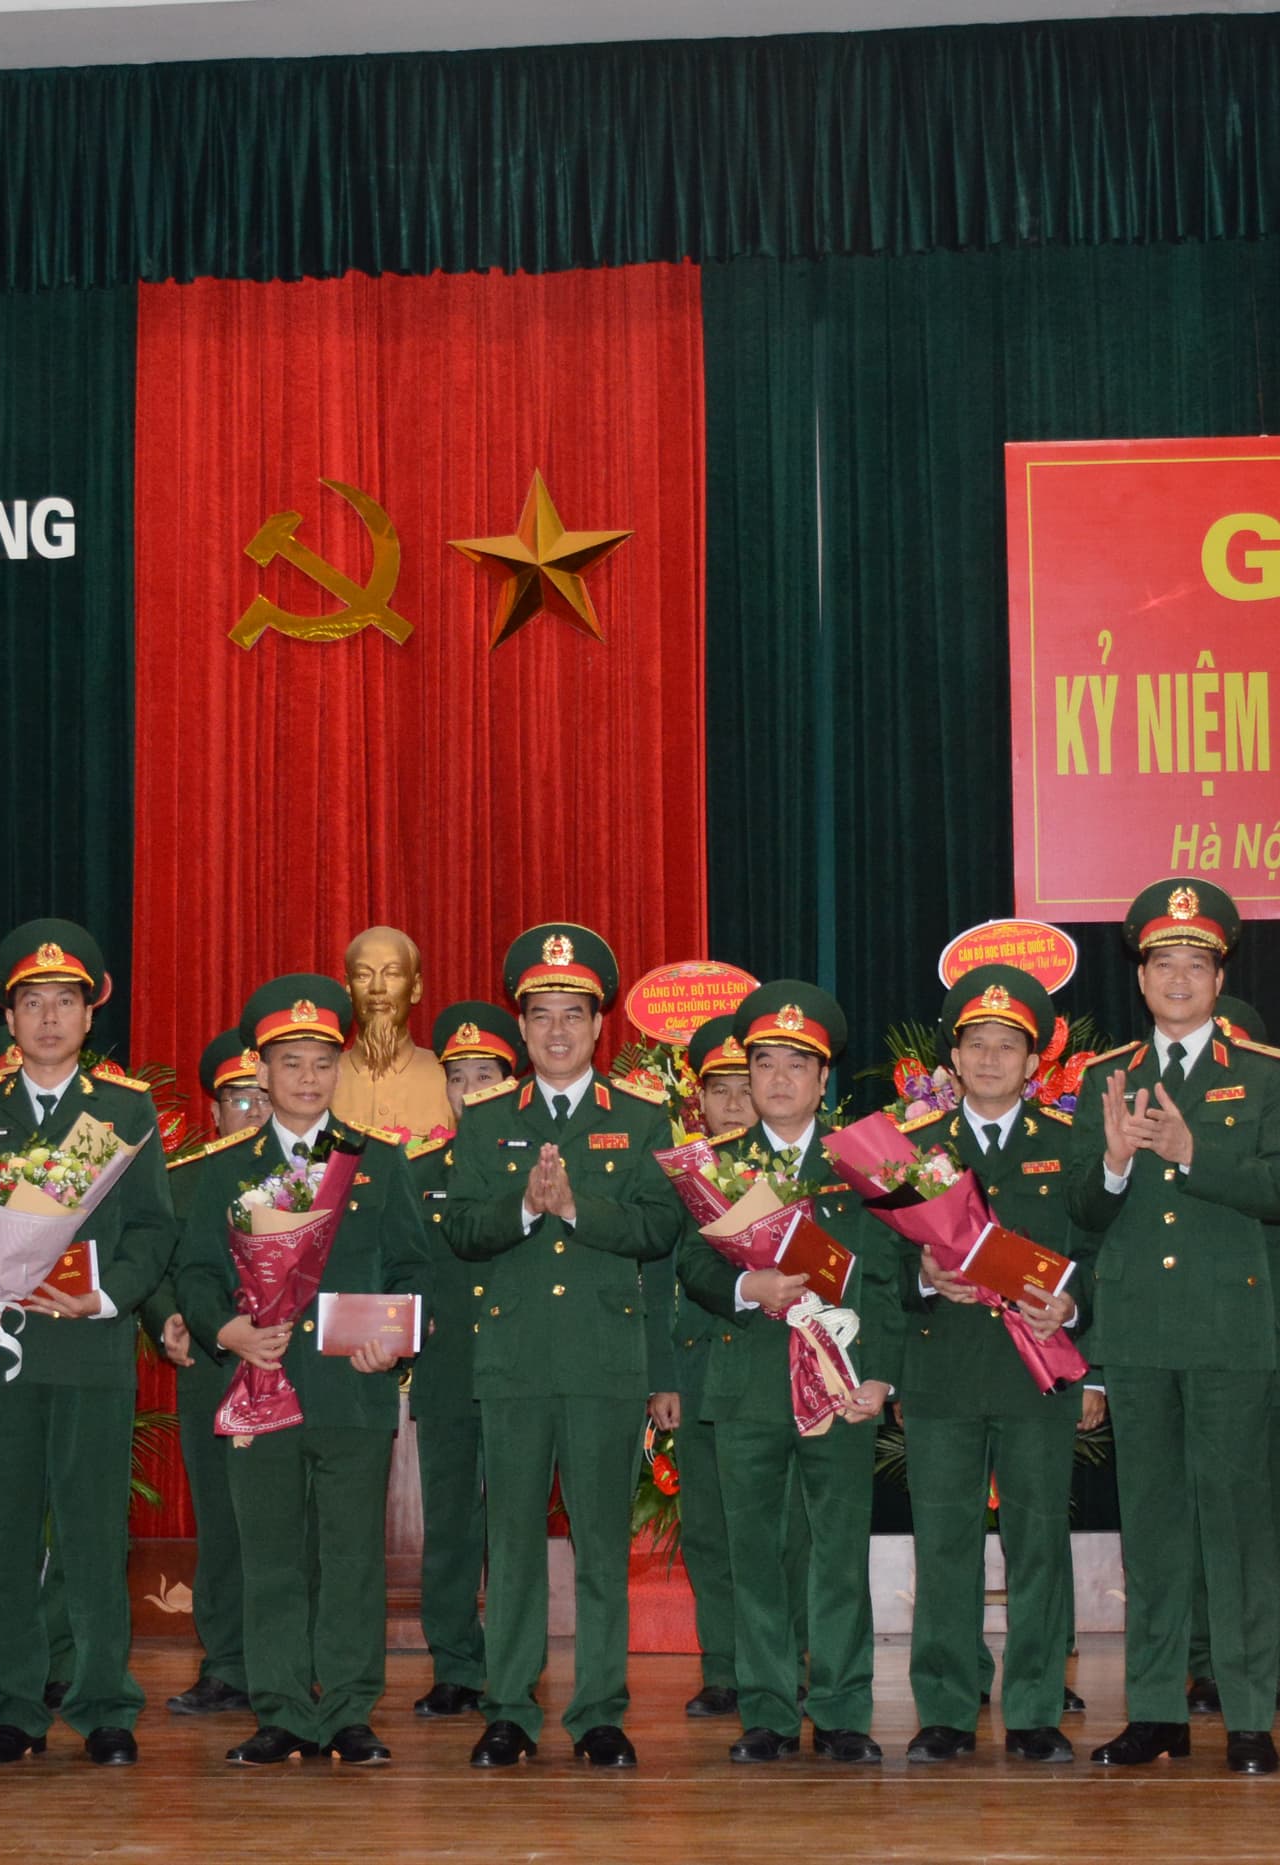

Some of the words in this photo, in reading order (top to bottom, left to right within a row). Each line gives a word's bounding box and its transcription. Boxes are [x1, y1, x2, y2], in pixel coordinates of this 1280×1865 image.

[1055, 628, 1120, 776] KỶ
[1135, 649, 1271, 798] NIỆM
[1169, 821, 1223, 871] Hà
[643, 984, 670, 998] ĐẢNG
[721, 981, 748, 996] LỆNH
